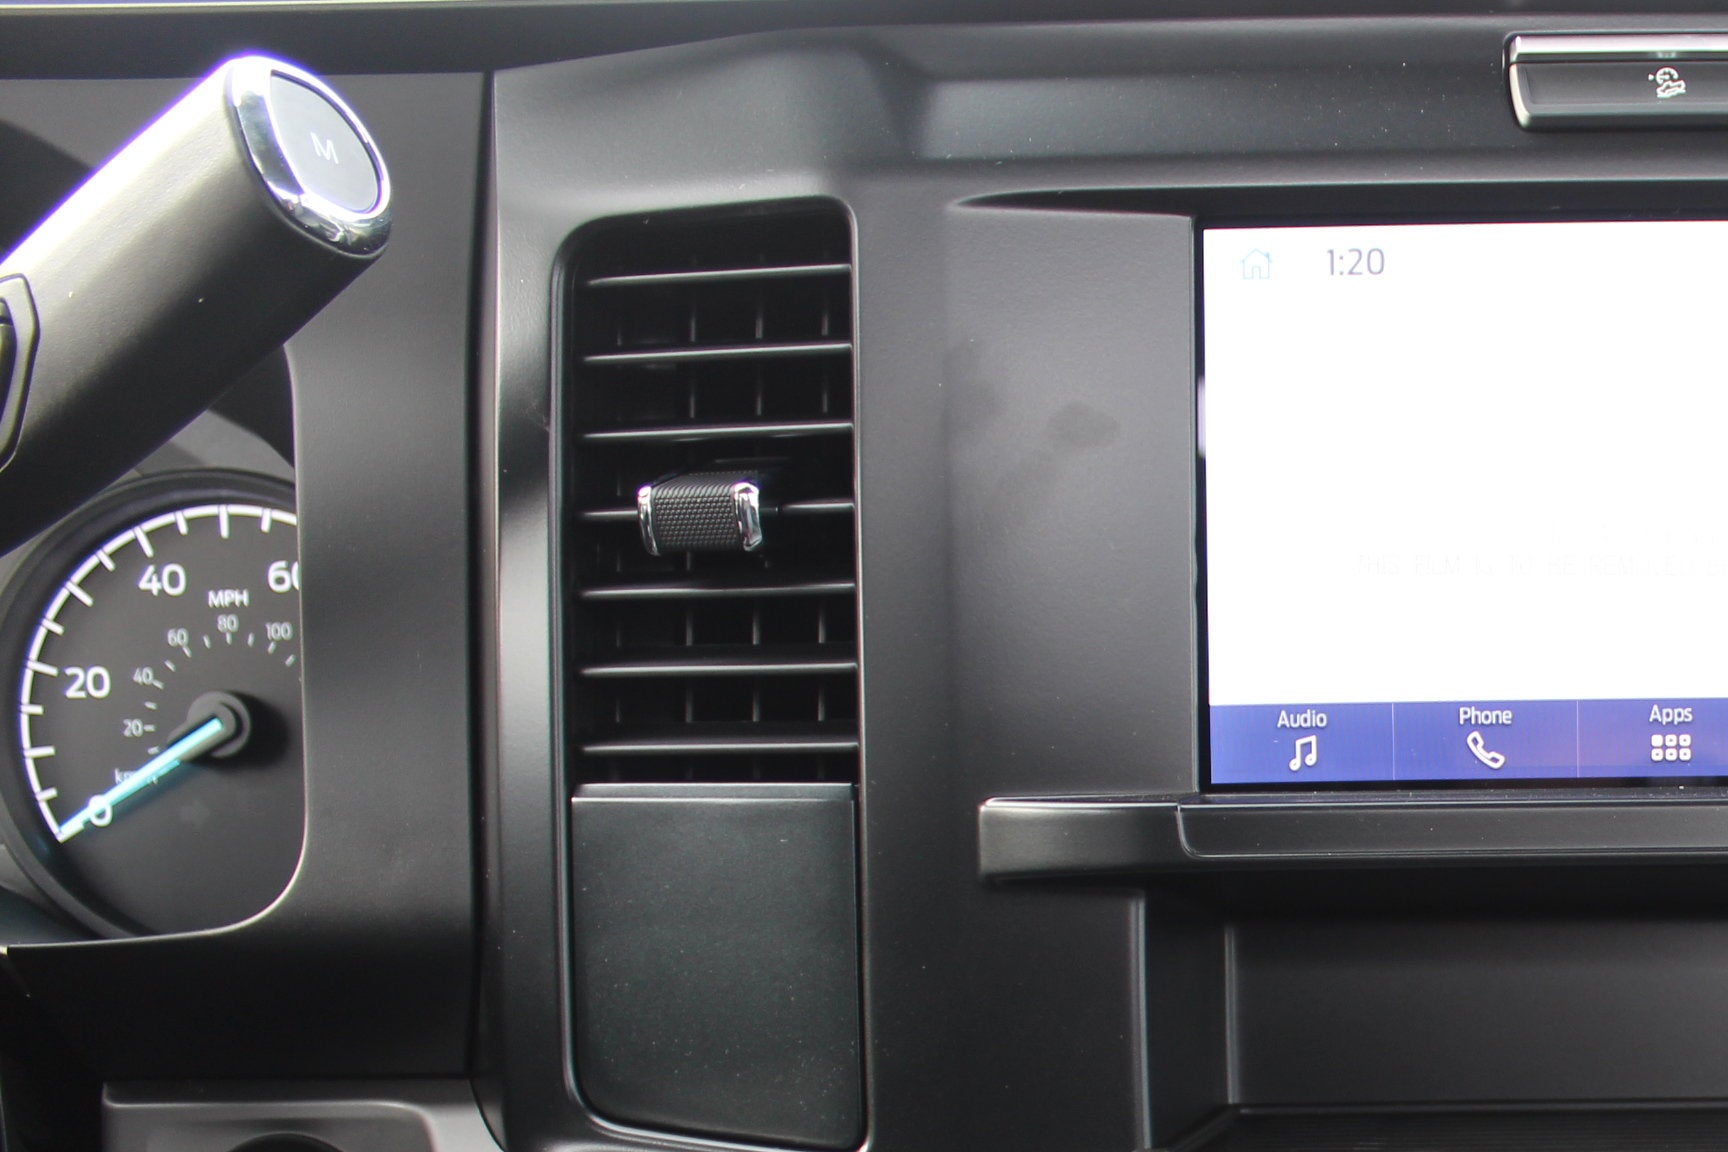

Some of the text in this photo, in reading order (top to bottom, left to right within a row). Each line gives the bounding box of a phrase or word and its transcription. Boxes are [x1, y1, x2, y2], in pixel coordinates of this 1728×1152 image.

[309, 131, 339, 165] M
[1326, 247, 1386, 276] 1:20
[138, 563, 187, 596] 40
[208, 589, 250, 608] MPH
[217, 614, 240, 633] 80
[265, 622, 293, 641] 100
[166, 627, 189, 647] 60
[64, 665, 111, 699] 20
[132, 666, 154, 686] 40
[1277, 709, 1328, 729] Audio
[1459, 706, 1513, 725] Phone
[1649, 704, 1693, 726] Apps
[122, 718, 144, 738] 20
